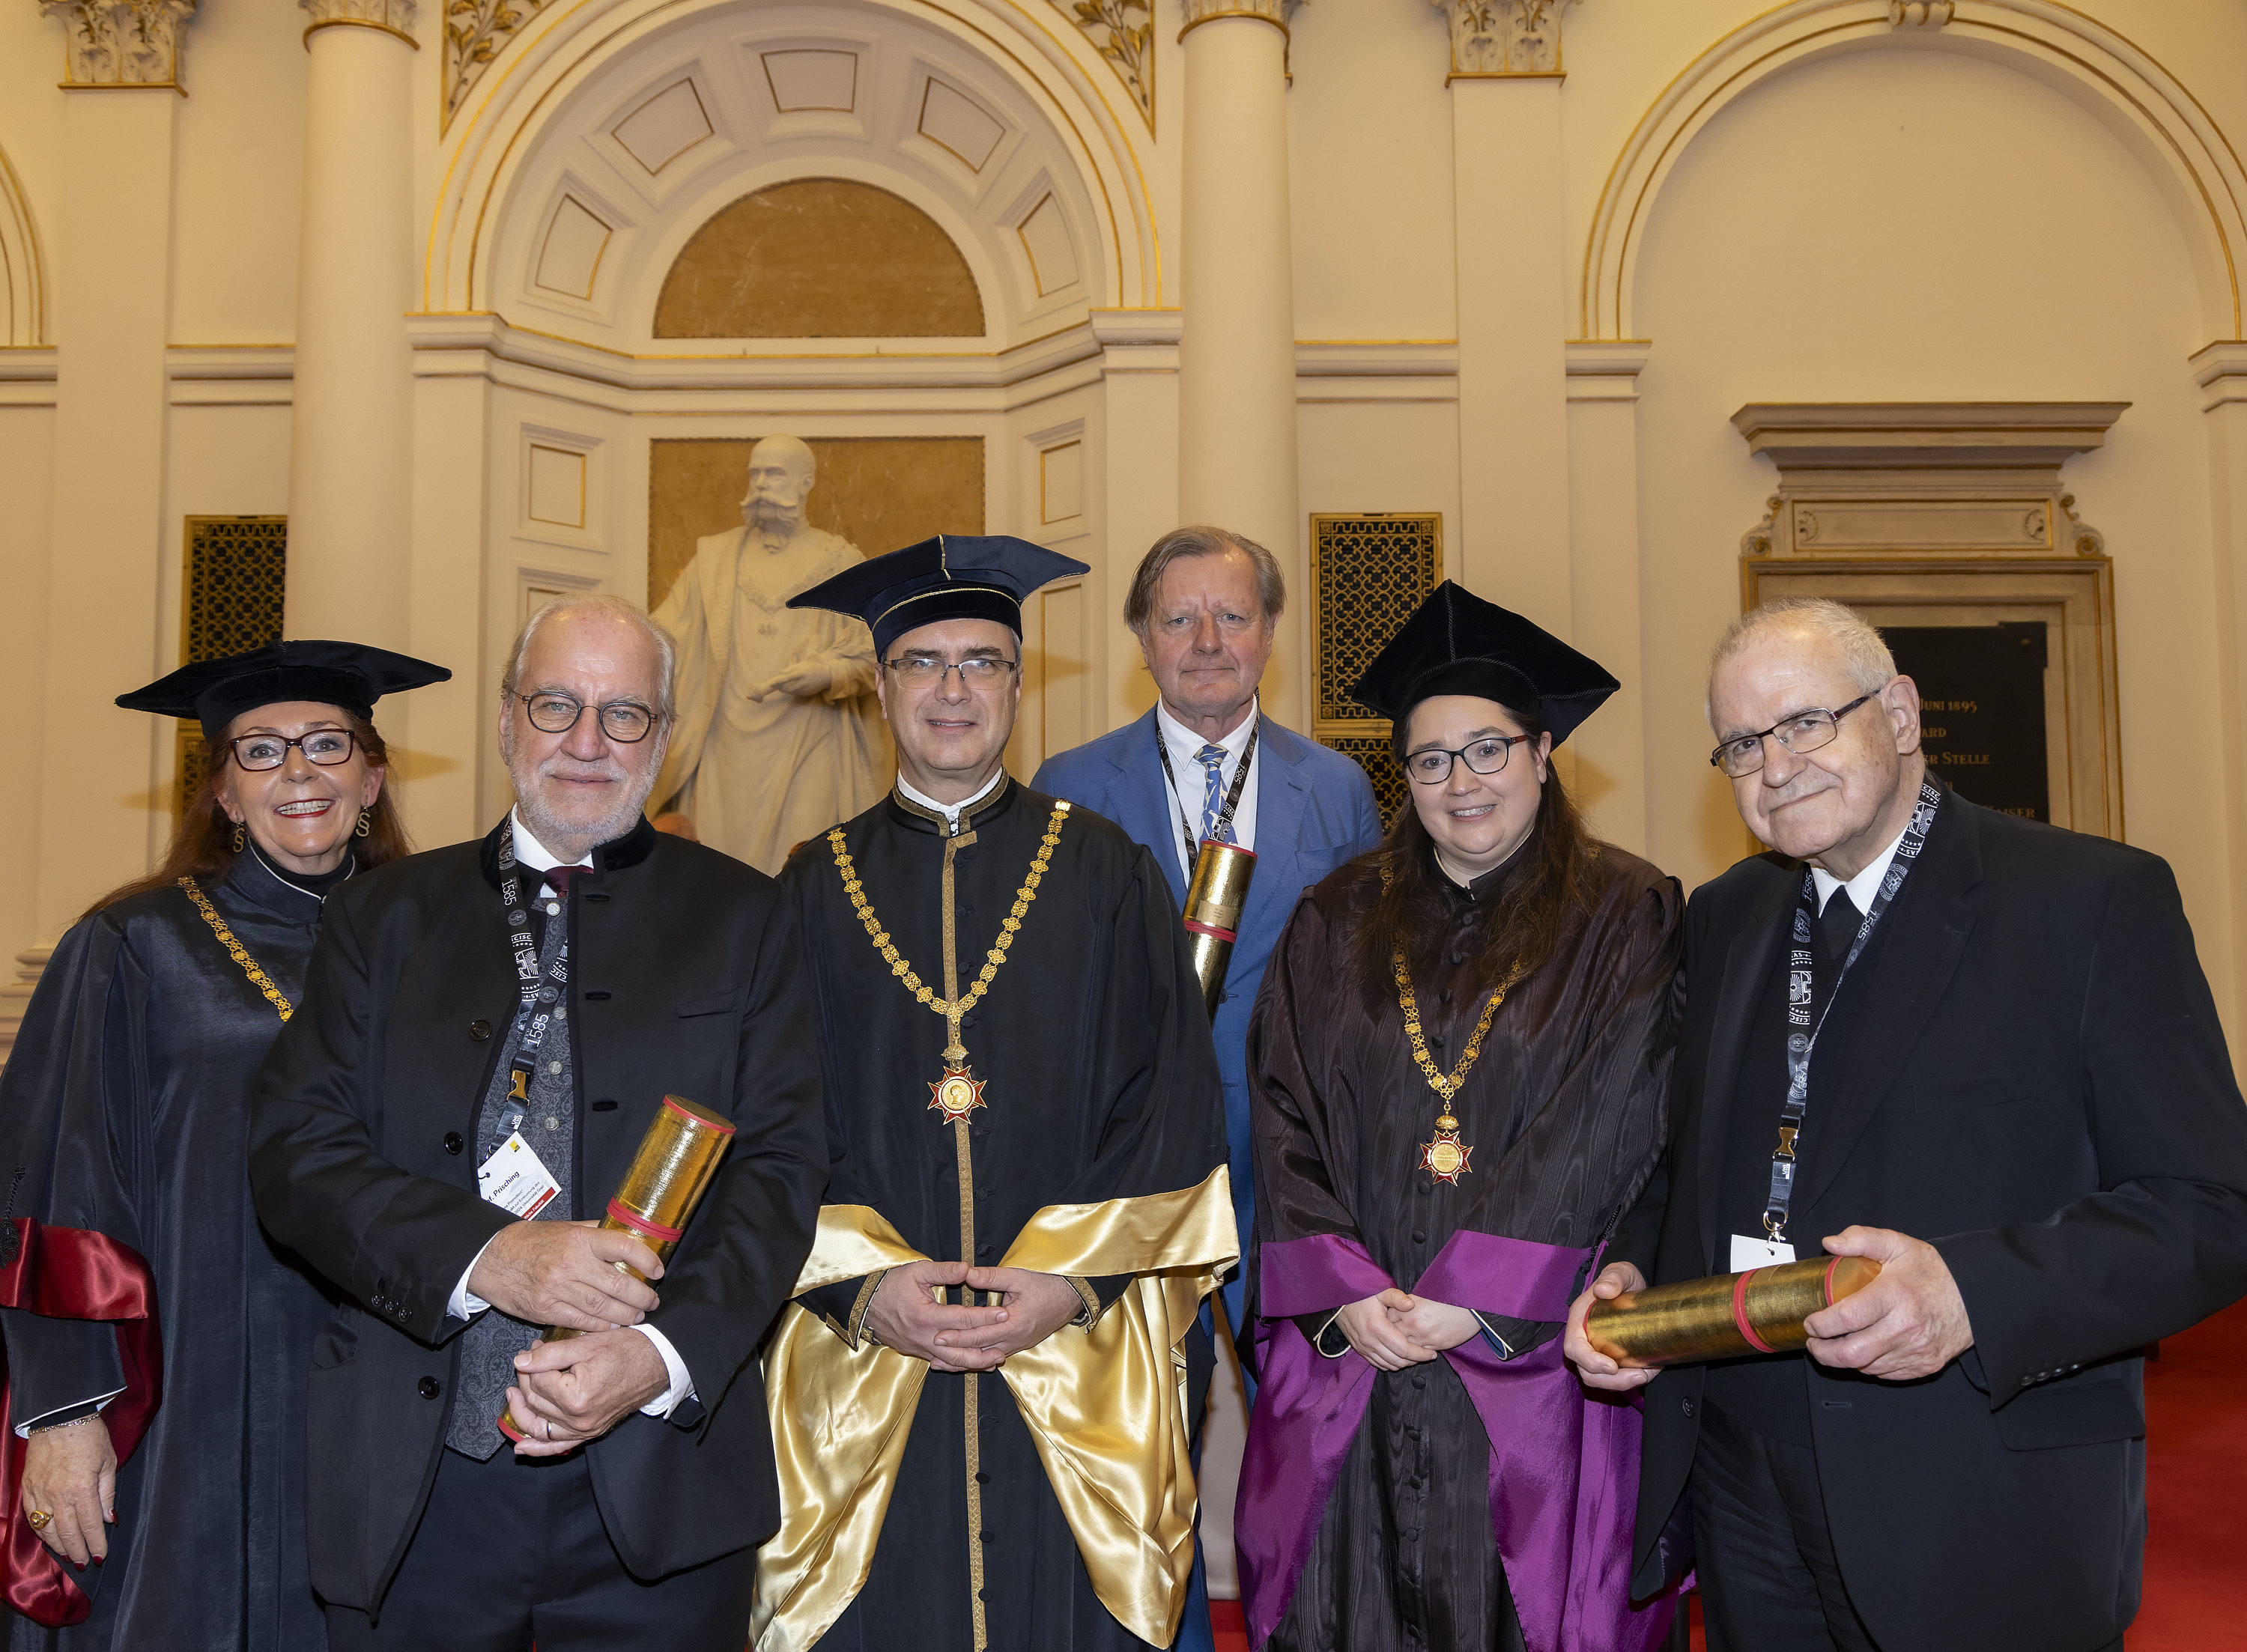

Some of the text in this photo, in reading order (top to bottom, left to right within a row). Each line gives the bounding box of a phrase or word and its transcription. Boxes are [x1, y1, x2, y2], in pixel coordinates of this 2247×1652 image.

[1948, 701, 1977, 713] 1895
[1920, 727, 1947, 738] ARD
[1942, 752, 1990, 765] STELLE
[1234, 761, 1246, 785] 1585
[502, 878, 517, 905] 1585
[1804, 872, 1813, 904] 1585
[1858, 909, 1877, 941] 1585
[527, 1013, 548, 1048] 1585
[493, 1170, 519, 1196] Prisching
